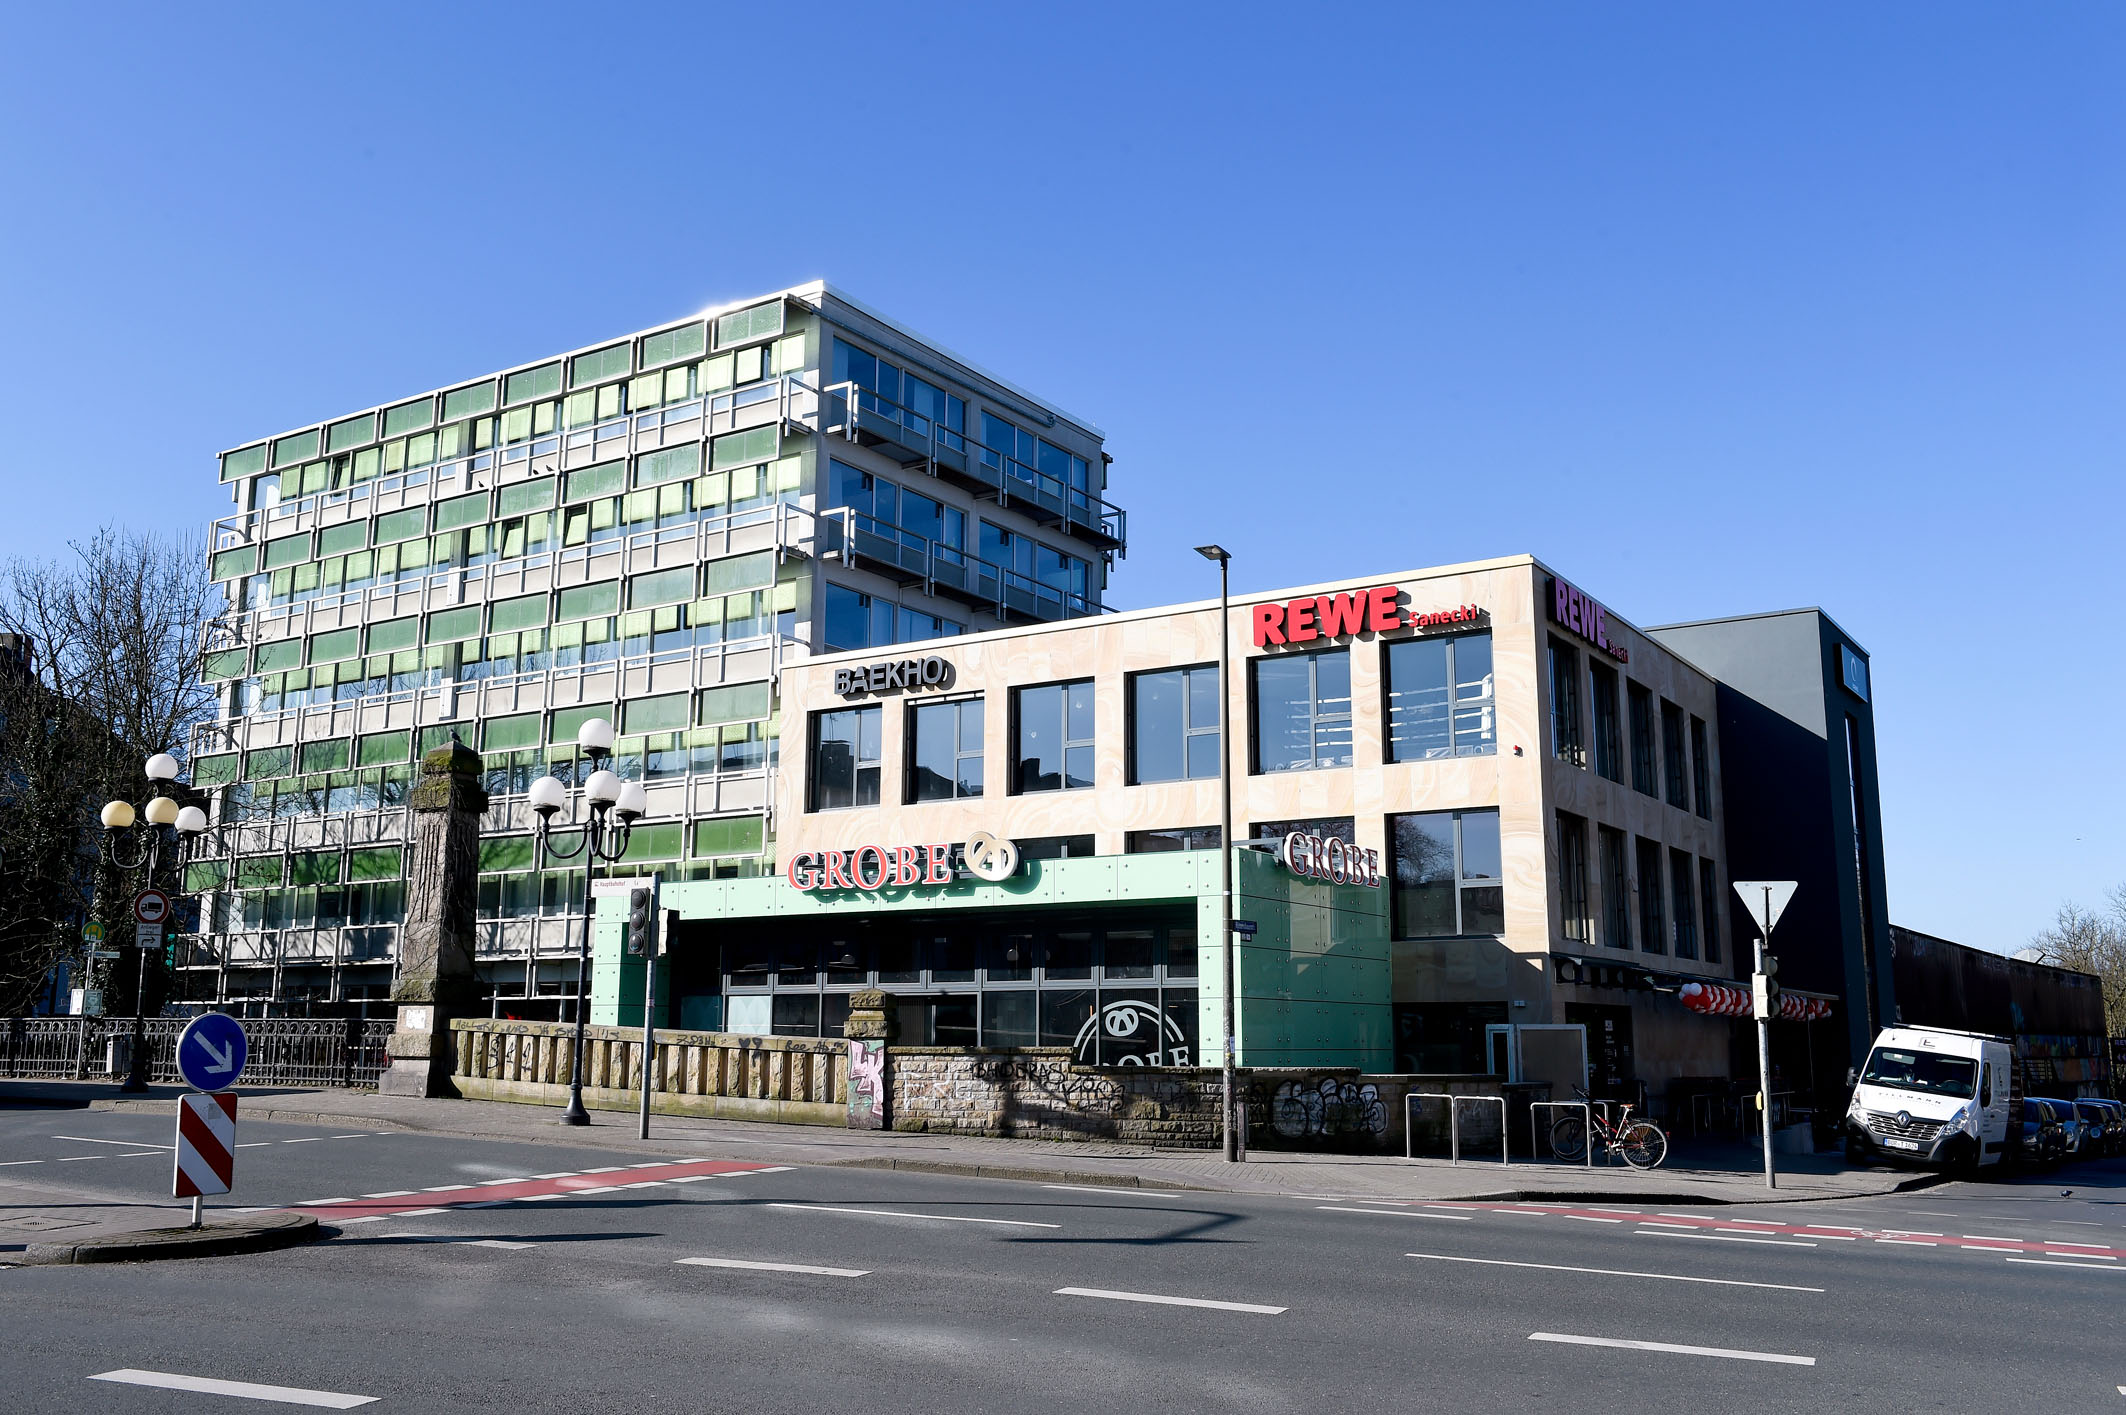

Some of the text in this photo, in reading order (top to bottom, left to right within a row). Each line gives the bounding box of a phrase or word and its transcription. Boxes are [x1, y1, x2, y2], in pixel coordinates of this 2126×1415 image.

[1253, 586, 1477, 647] REWE Sanecki
[1555, 578, 1608, 650] REWE
[834, 656, 943, 695] BAEKHO
[787, 844, 953, 891] GROBE
[1288, 832, 1380, 888] GROBE
